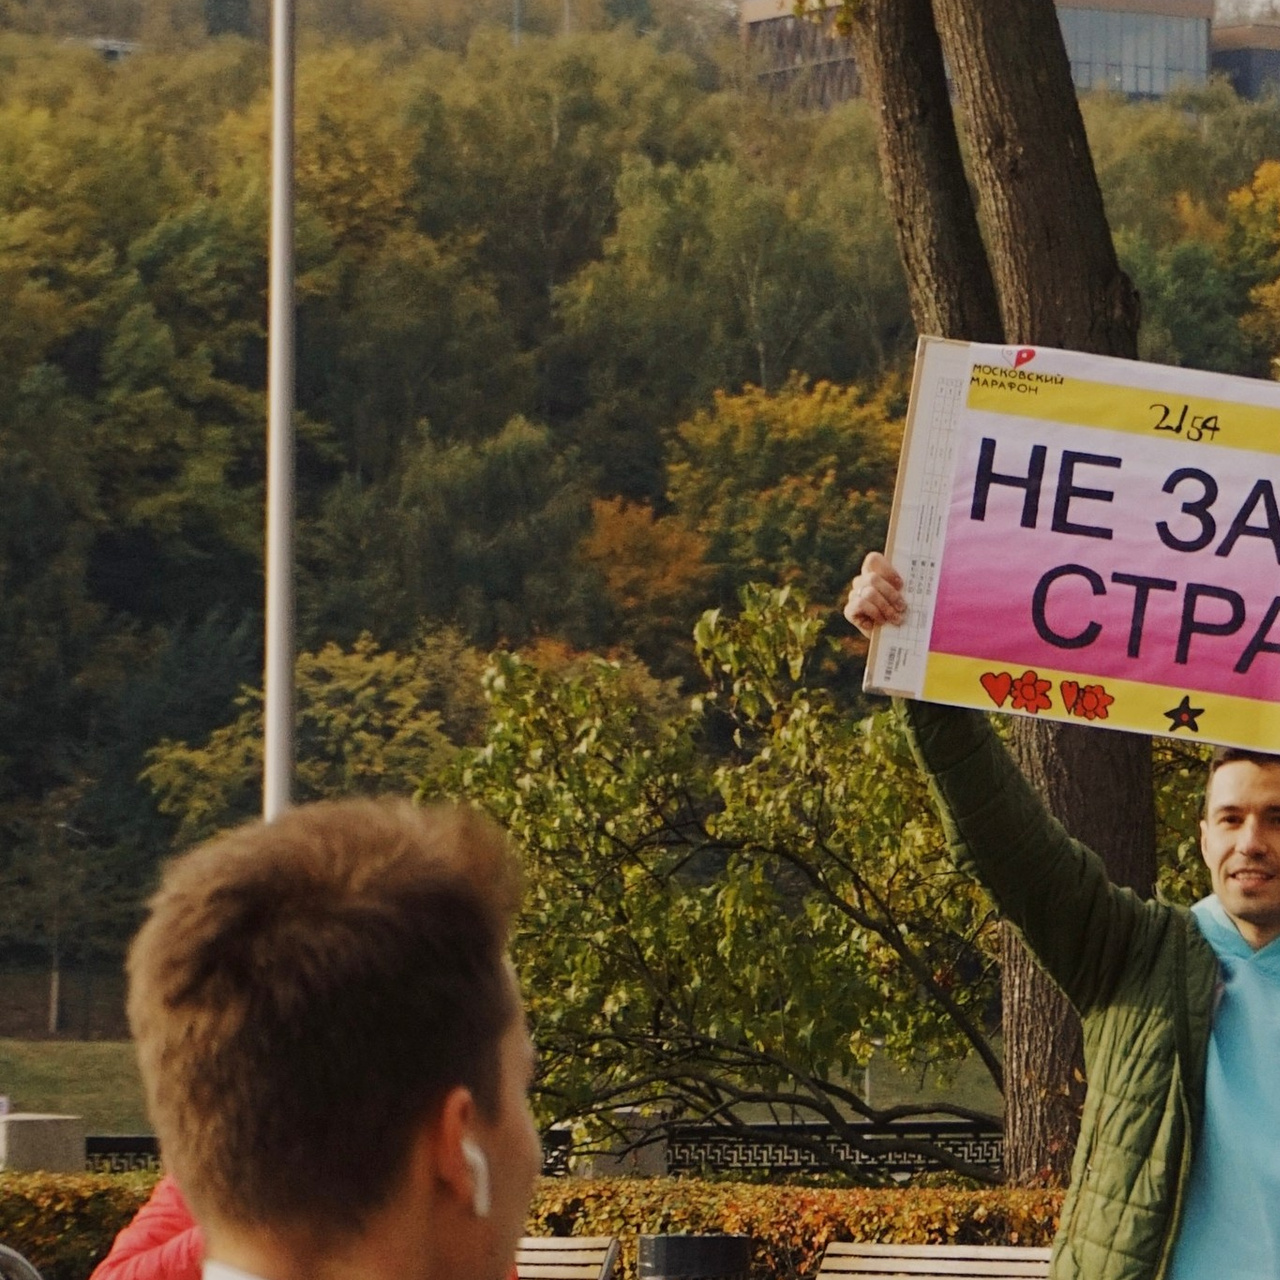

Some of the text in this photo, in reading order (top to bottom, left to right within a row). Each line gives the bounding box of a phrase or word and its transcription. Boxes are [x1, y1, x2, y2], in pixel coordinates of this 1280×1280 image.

[972, 363, 1065, 385] МОСКОВСКИЙ
[969, 376, 1039, 396] МАРАФОН
[970, 437, 1123, 540] НЕ
